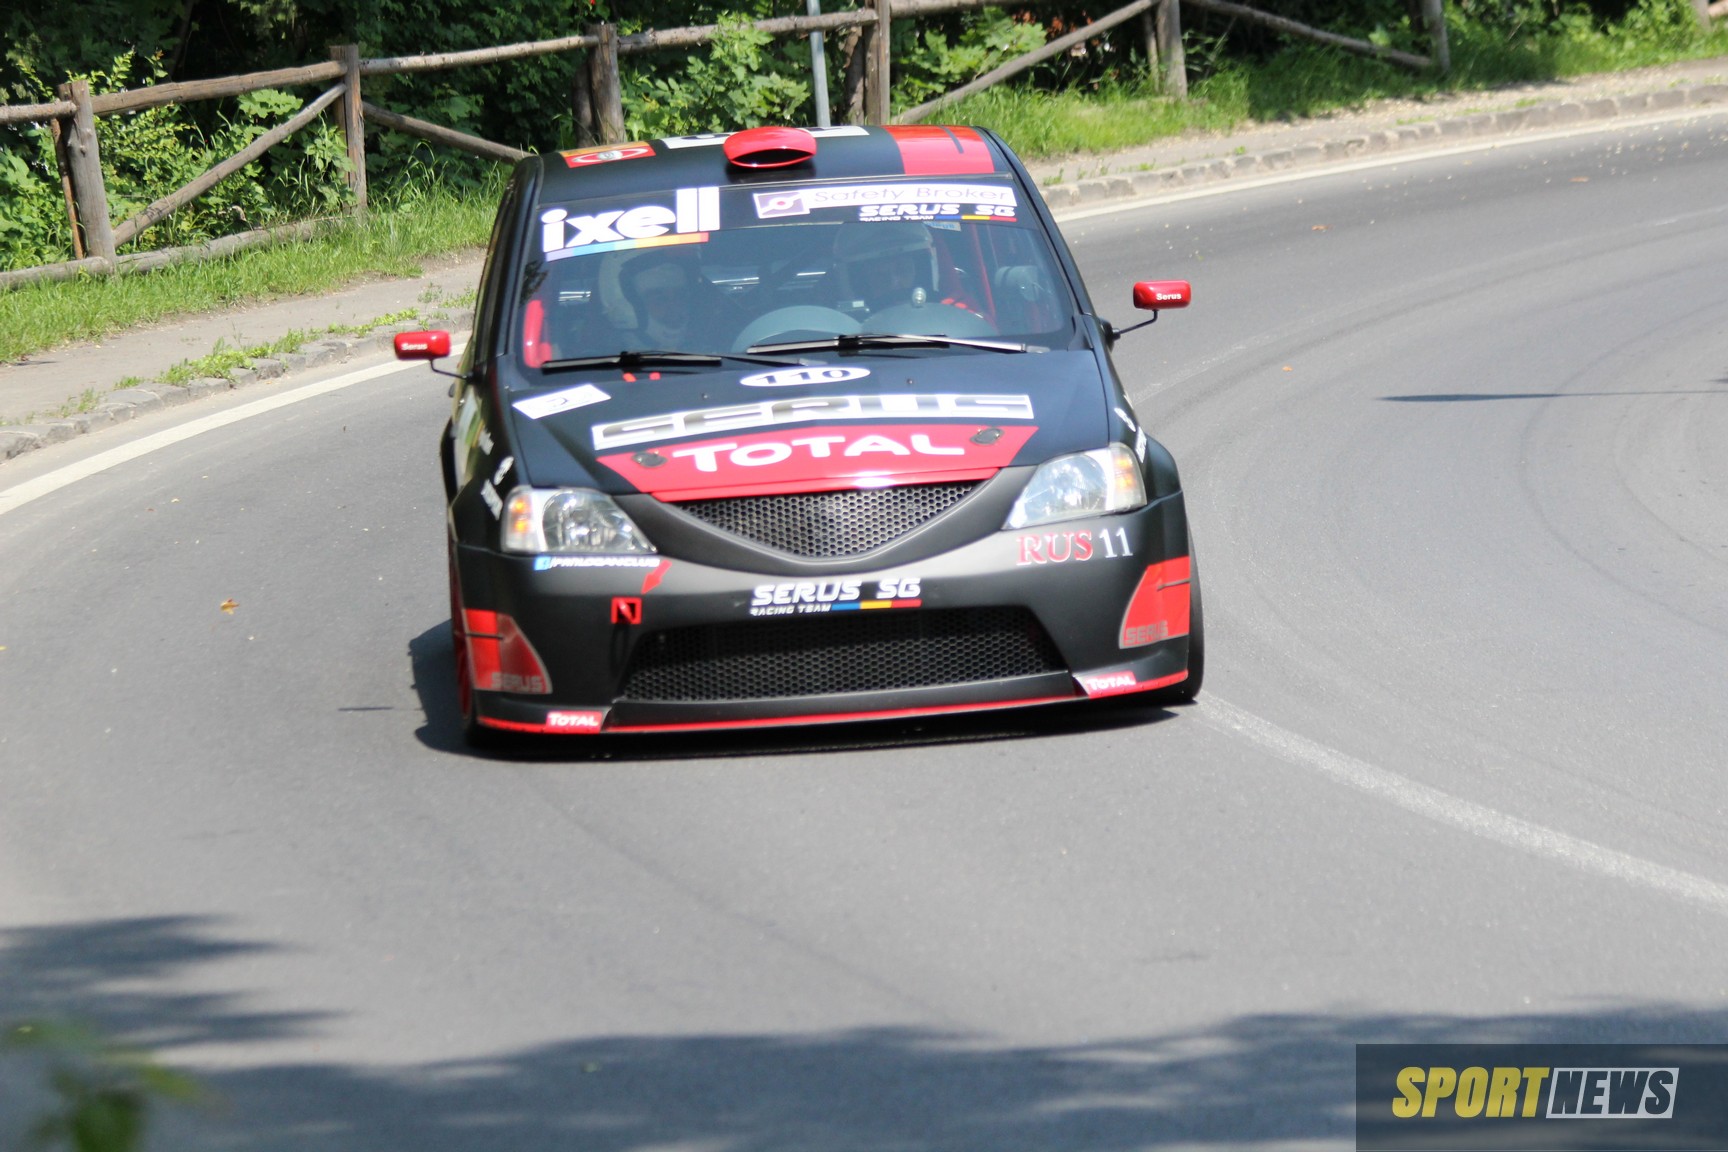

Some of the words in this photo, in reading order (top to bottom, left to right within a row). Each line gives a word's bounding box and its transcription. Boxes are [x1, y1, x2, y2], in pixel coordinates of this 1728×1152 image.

[814, 188, 903, 203] Safety
[916, 187, 1009, 201] Broker
[859, 204, 960, 217] SERUS
[974, 204, 1016, 217] SG
[541, 187, 720, 252] ixell
[1156, 292, 1183, 301] Serus
[401, 342, 428, 351] Serus
[593, 395, 1034, 449] SERUS
[673, 433, 965, 472] TOTAL
[1016, 529, 1094, 566] RUS
[1098, 526, 1134, 559] 11
[751, 580, 863, 606] SERUS
[876, 577, 922, 600] SG
[750, 604, 795, 617] RACING
[797, 602, 832, 614] TEAM
[1086, 675, 1137, 691] TOTAL
[548, 713, 600, 727] TOTAL
